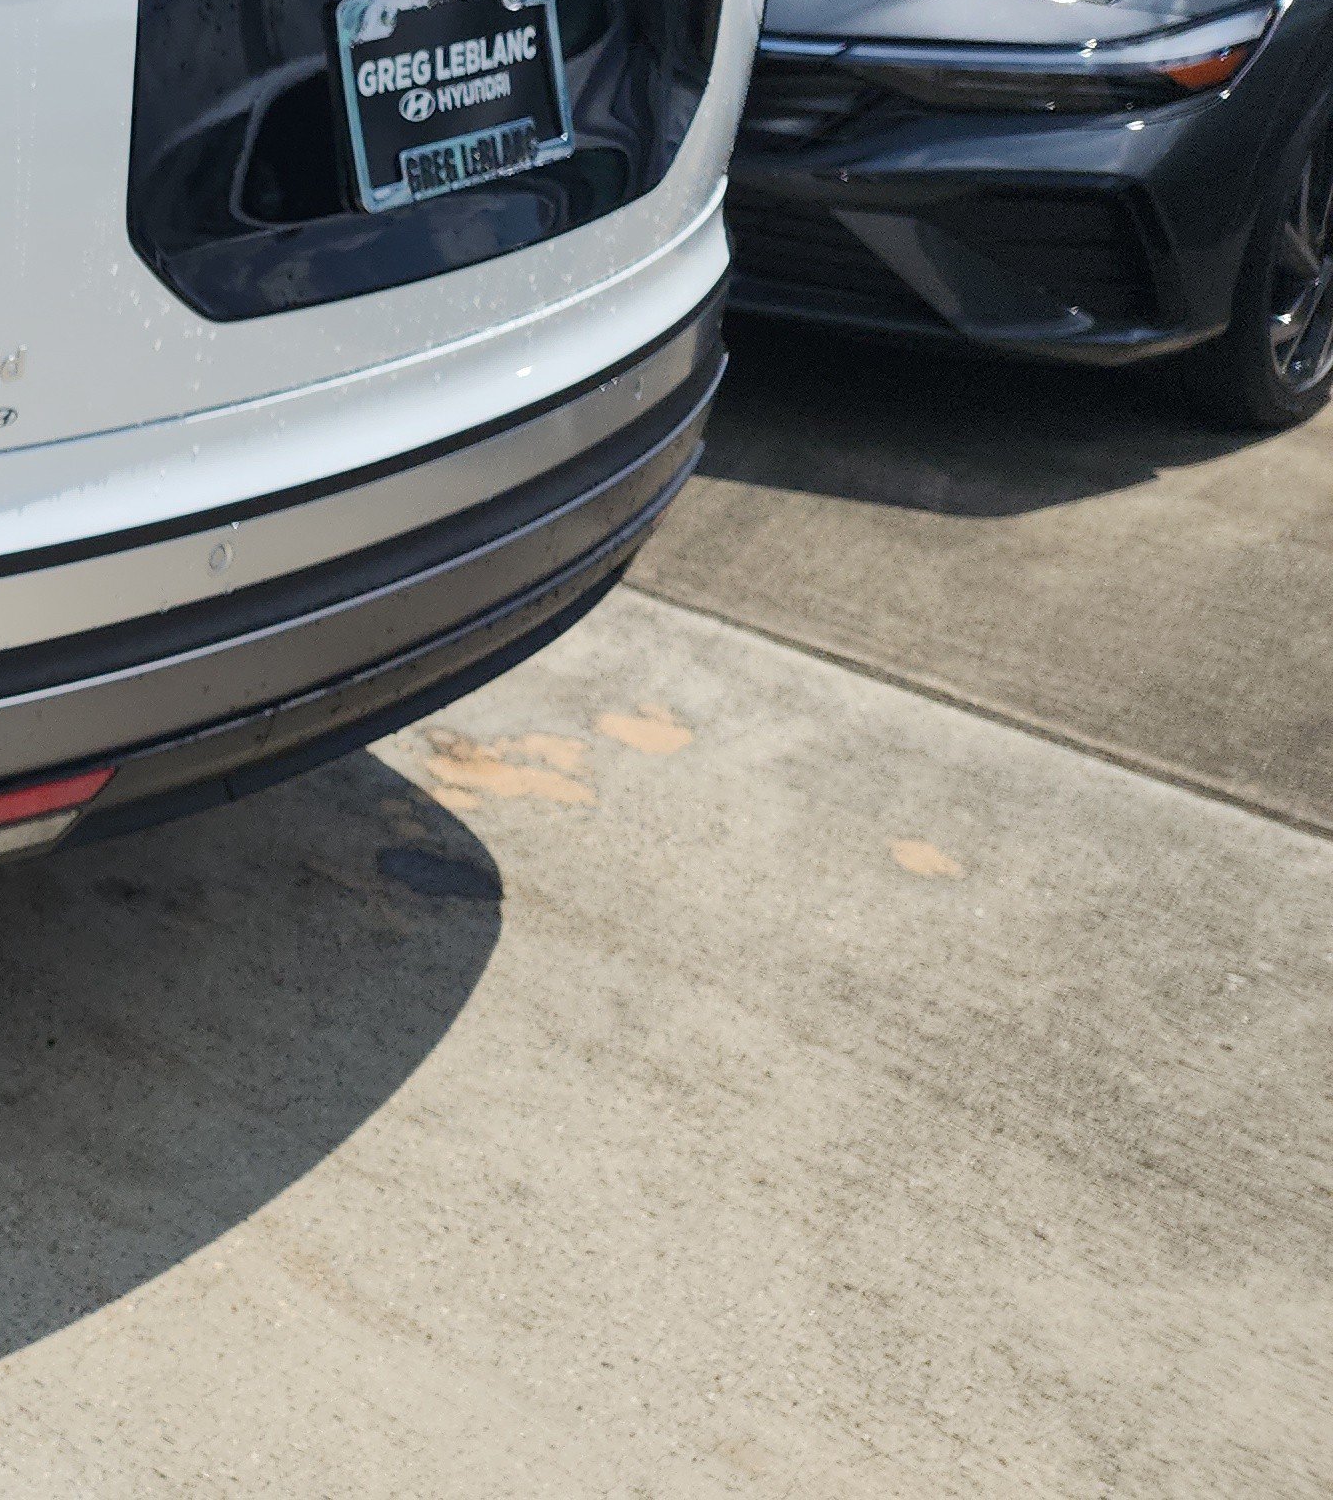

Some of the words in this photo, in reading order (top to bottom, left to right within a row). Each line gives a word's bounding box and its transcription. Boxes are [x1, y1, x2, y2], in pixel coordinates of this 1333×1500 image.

[358, 49, 432, 98] GREG
[435, 25, 537, 81] LEBLANC
[436, 71, 512, 113] HYUNDAI
